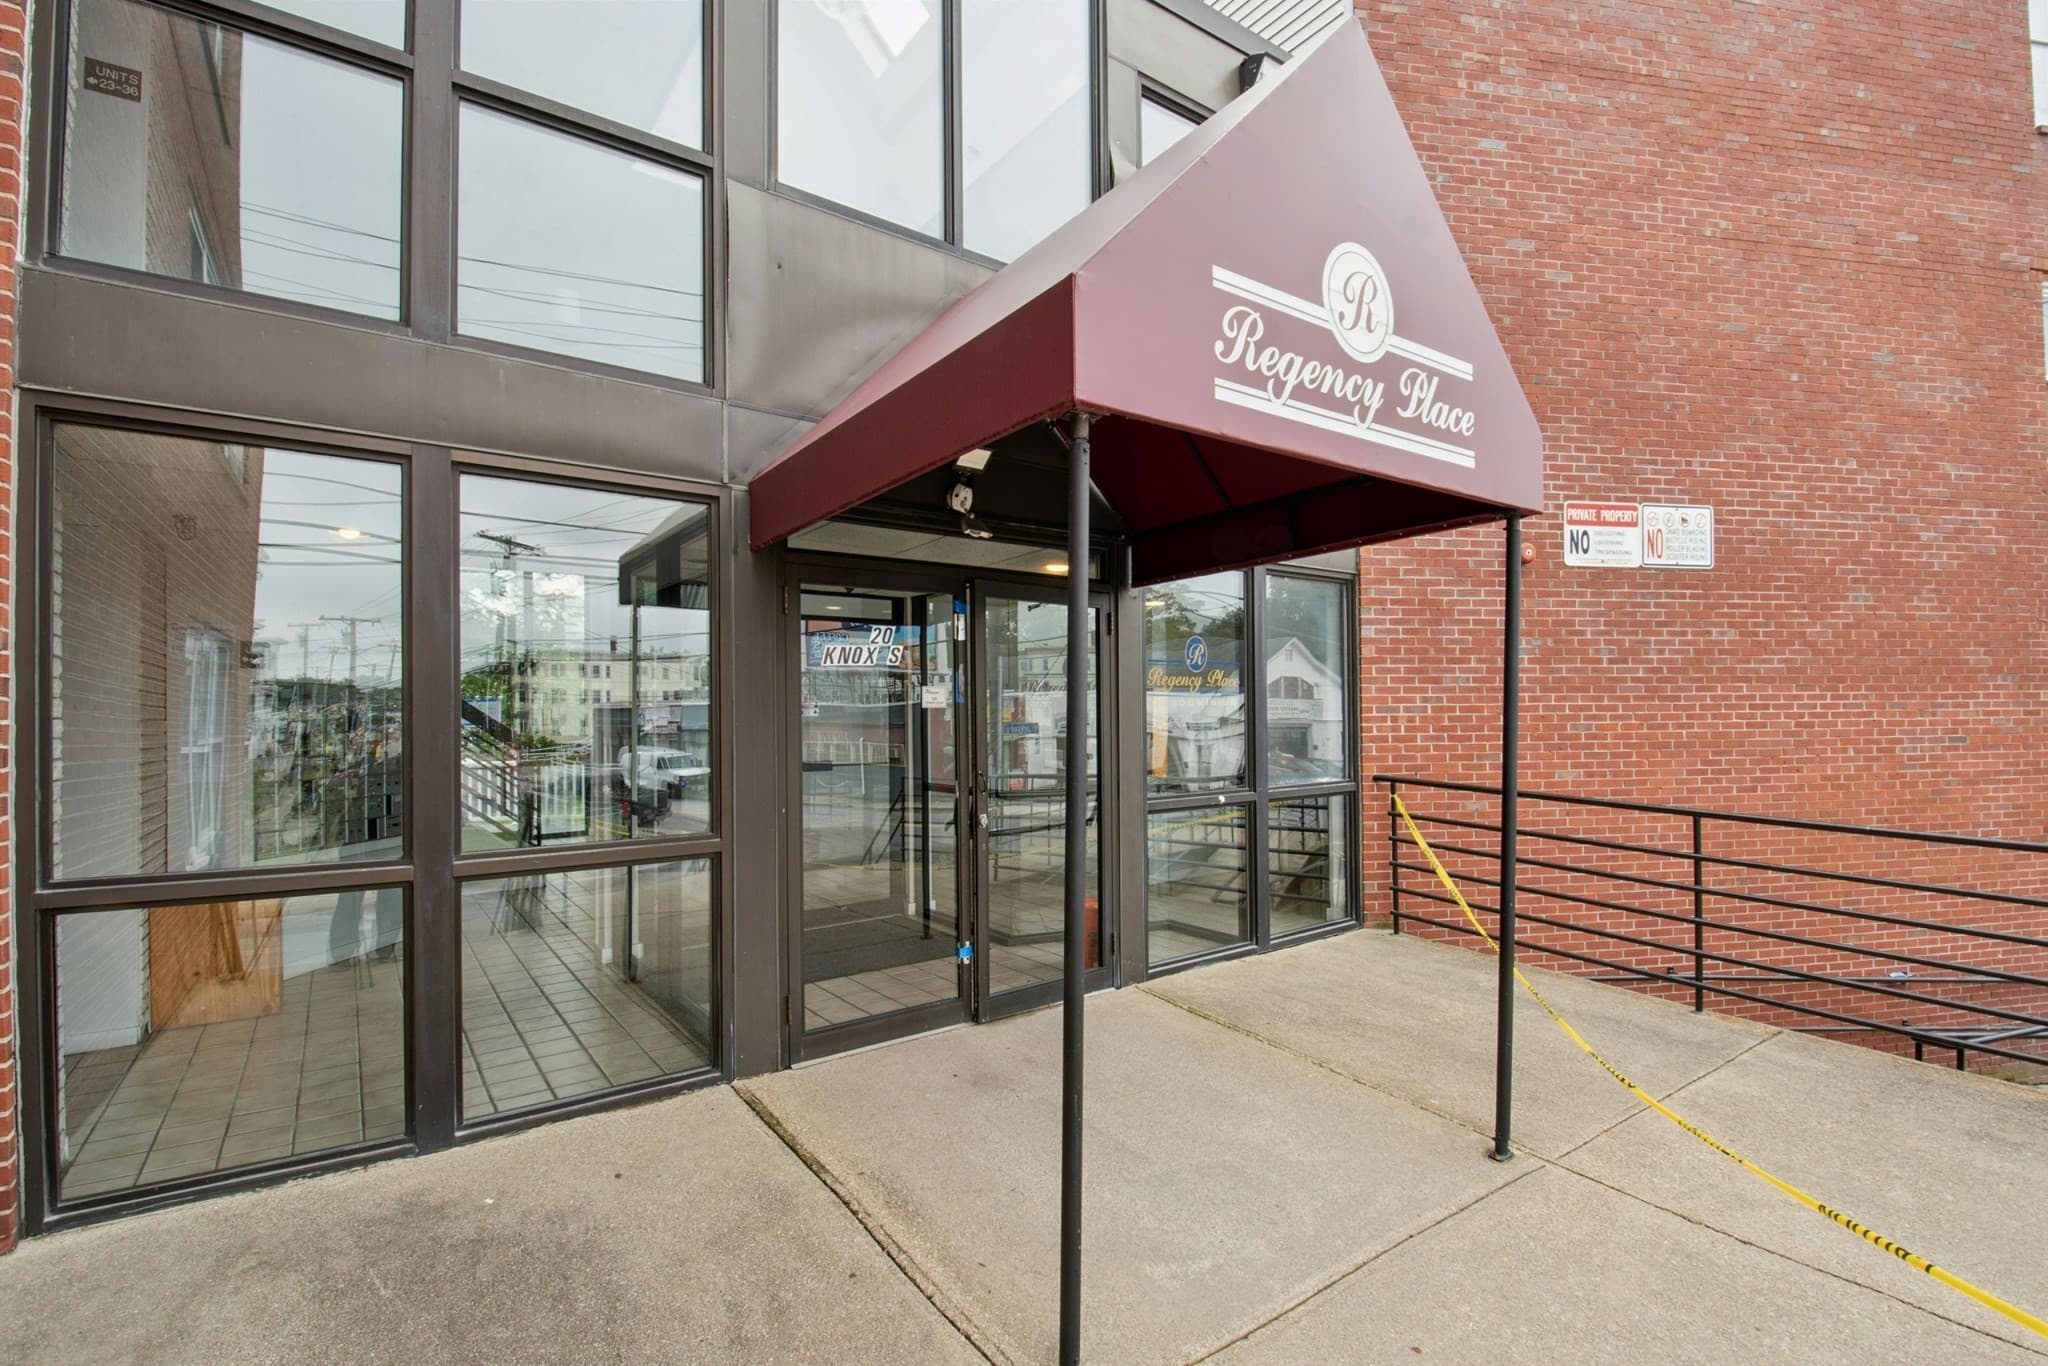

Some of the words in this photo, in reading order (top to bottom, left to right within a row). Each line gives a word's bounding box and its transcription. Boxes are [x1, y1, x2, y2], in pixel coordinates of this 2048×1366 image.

[96, 65, 138, 85] UNITS
[99, 79, 138, 96] 23-36
[1338, 271, 1379, 334] R
[1214, 305, 1385, 430] Regency
[1396, 367, 1475, 437] Place
[1567, 508, 1597, 521] PRIVATE
[1600, 509, 1638, 523] PROPERTY
[1570, 529, 1590, 554] NO
[1647, 528, 1664, 559] NO
[870, 627, 894, 644] 20
[823, 647, 878, 665] KNOX
[889, 647, 902, 665] S
[1187, 643, 1204, 666] R
[1147, 667, 1202, 692] Regency
[1206, 668, 1239, 688] Place
